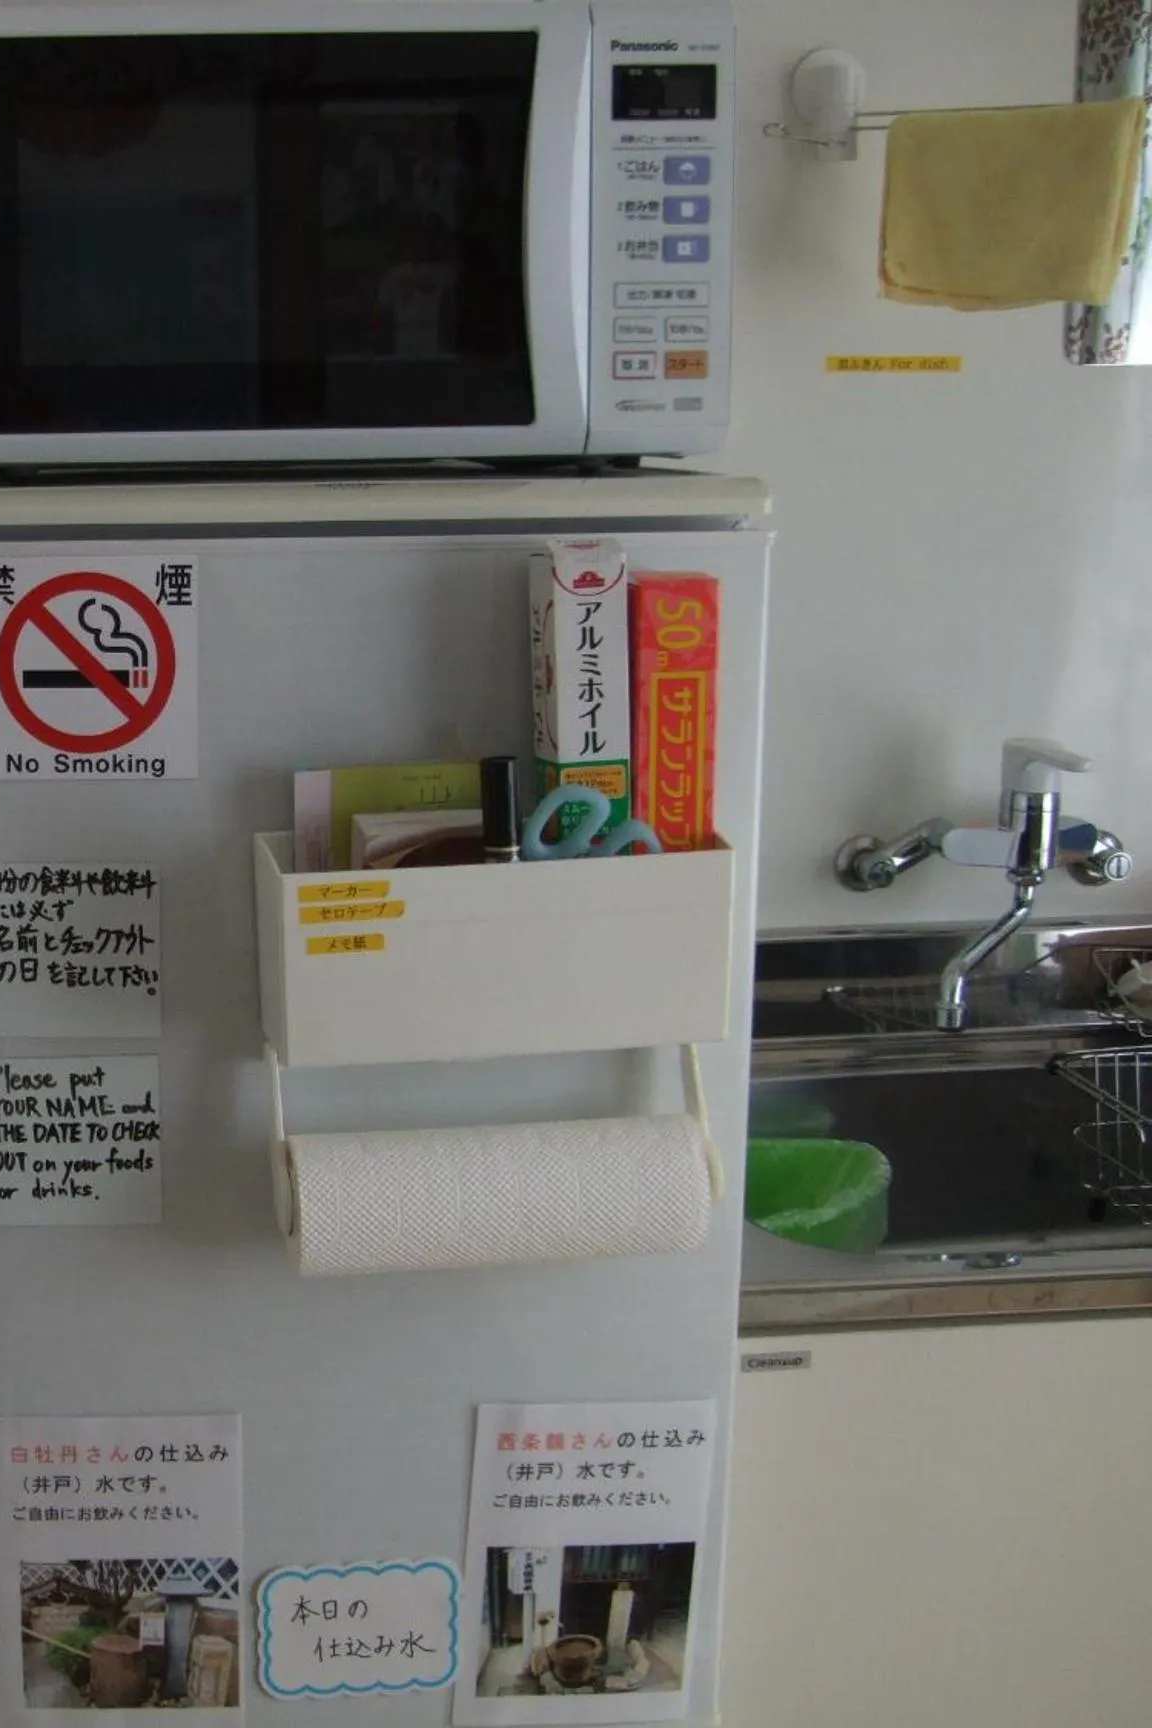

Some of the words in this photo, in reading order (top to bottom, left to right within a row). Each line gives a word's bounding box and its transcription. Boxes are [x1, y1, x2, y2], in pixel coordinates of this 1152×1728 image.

[610, 40, 679, 51] Panasonic
[155, 564, 193, 606] 煙
[575, 601, 606, 756] アルミホイル
[6, 754, 39, 773] No
[54, 754, 165, 777] Smoking
[318, 884, 372, 898] マーカー
[320, 903, 387, 920] セロテープ
[69, 1066, 105, 1099] put
[45, 1095, 116, 1118] NAME
[121, 1090, 156, 1114] and
[33, 1122, 83, 1144] DATE
[85, 1122, 109, 1142] TO
[111, 1119, 161, 1142] CHECK
[32, 1158, 57, 1173] on
[63, 1159, 102, 1186] your
[105, 1147, 155, 1174] foods
[31, 1177, 100, 1201] drinks.
[10, 1443, 229, 1465] 白牡丹さんの仕込み
[493, 1492, 671, 1509] ご自由にお飲みください。
[12, 1505, 199, 1522] ご自由にお飲みください。
[290, 1595, 368, 1626] 本日の
[313, 1631, 438, 1663] 仕込み水
